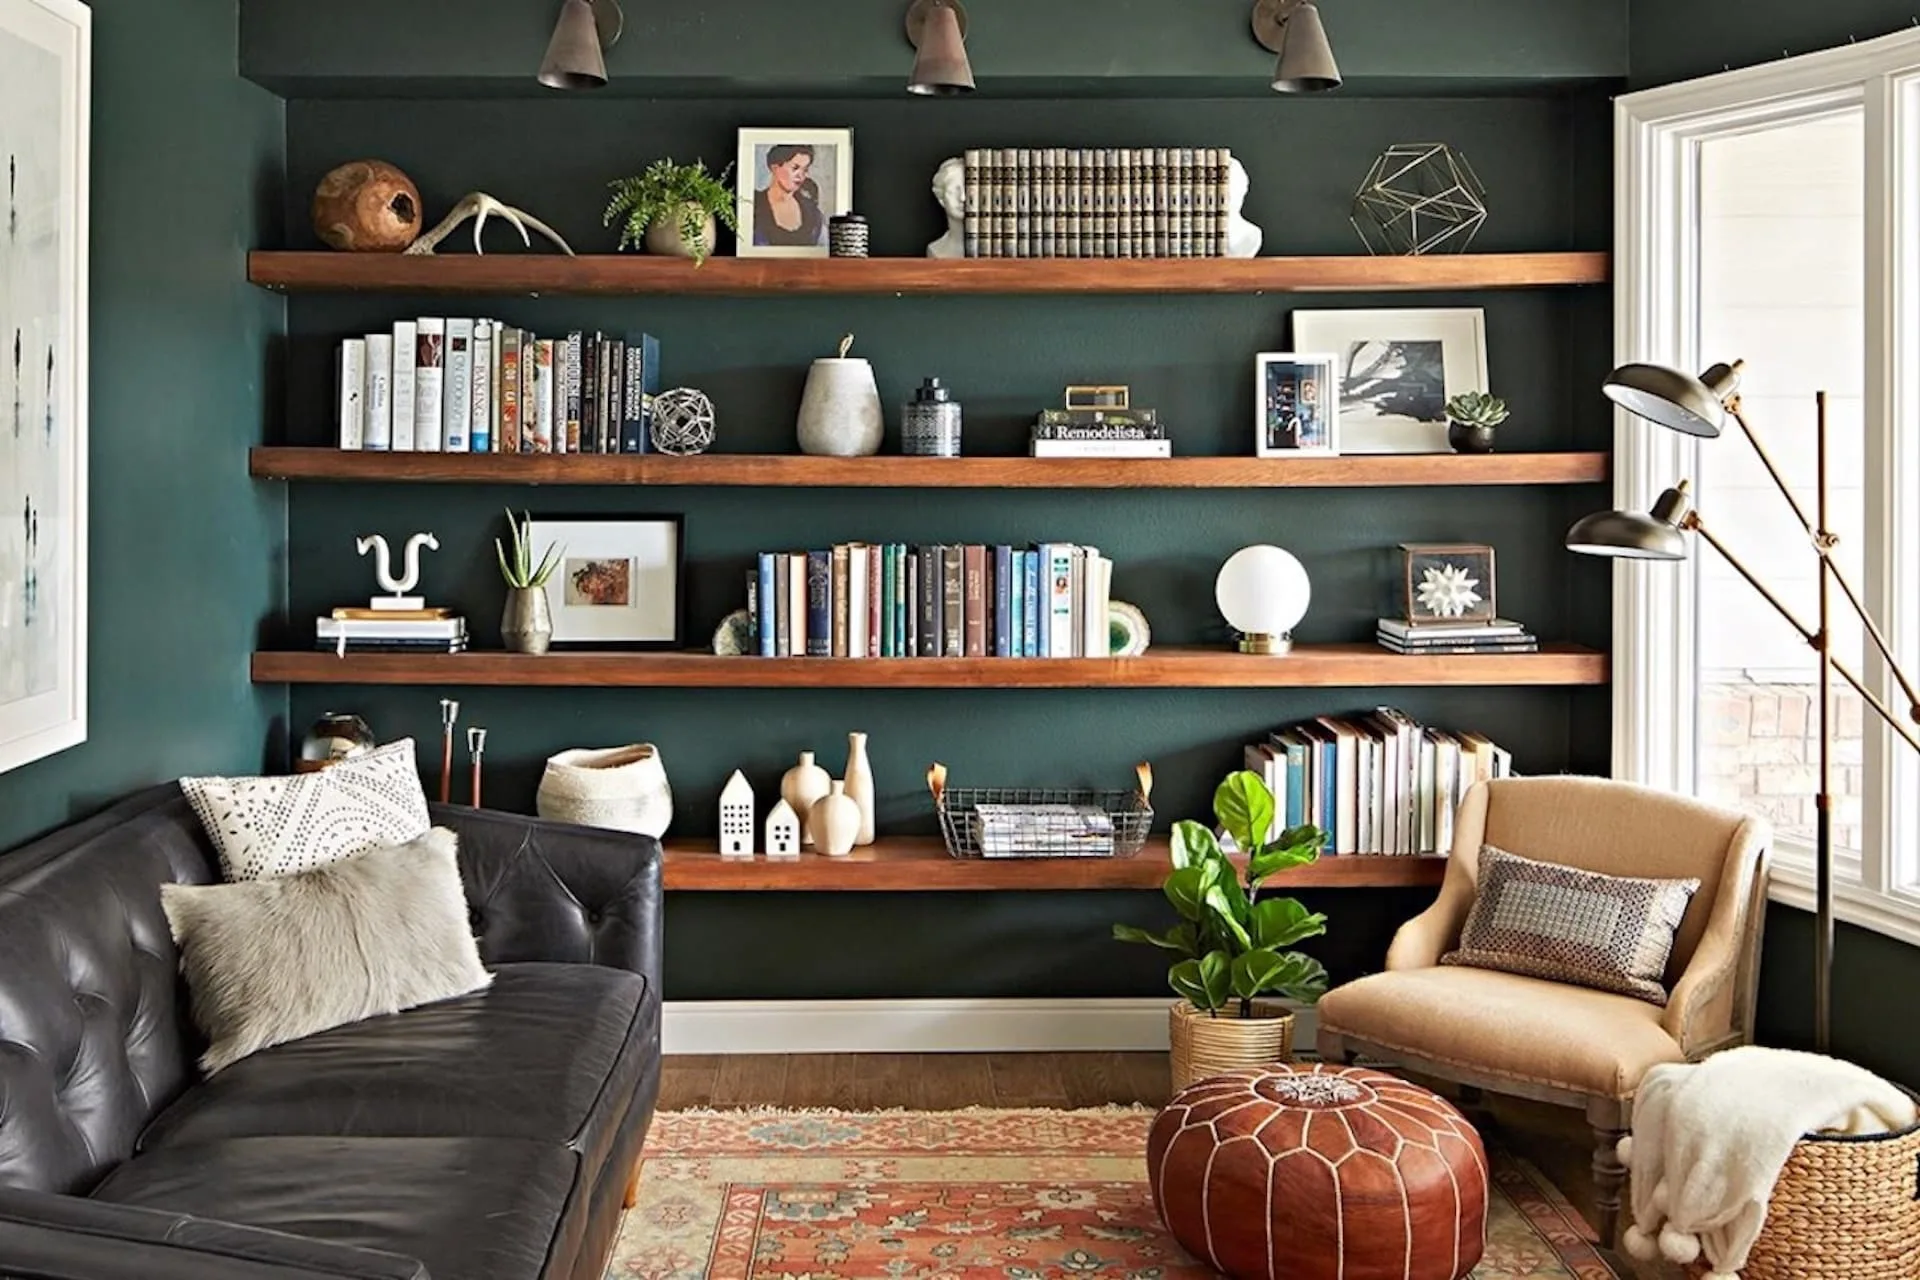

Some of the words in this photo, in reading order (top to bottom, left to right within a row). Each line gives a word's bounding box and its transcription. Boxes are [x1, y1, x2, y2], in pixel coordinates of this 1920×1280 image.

[454, 354, 466, 371] ON
[567, 333, 581, 397] SOURDOUGH
[453, 373, 465, 420] COOKING
[474, 365, 485, 417] BAKING
[1056, 424, 1146, 440] Remodelista
